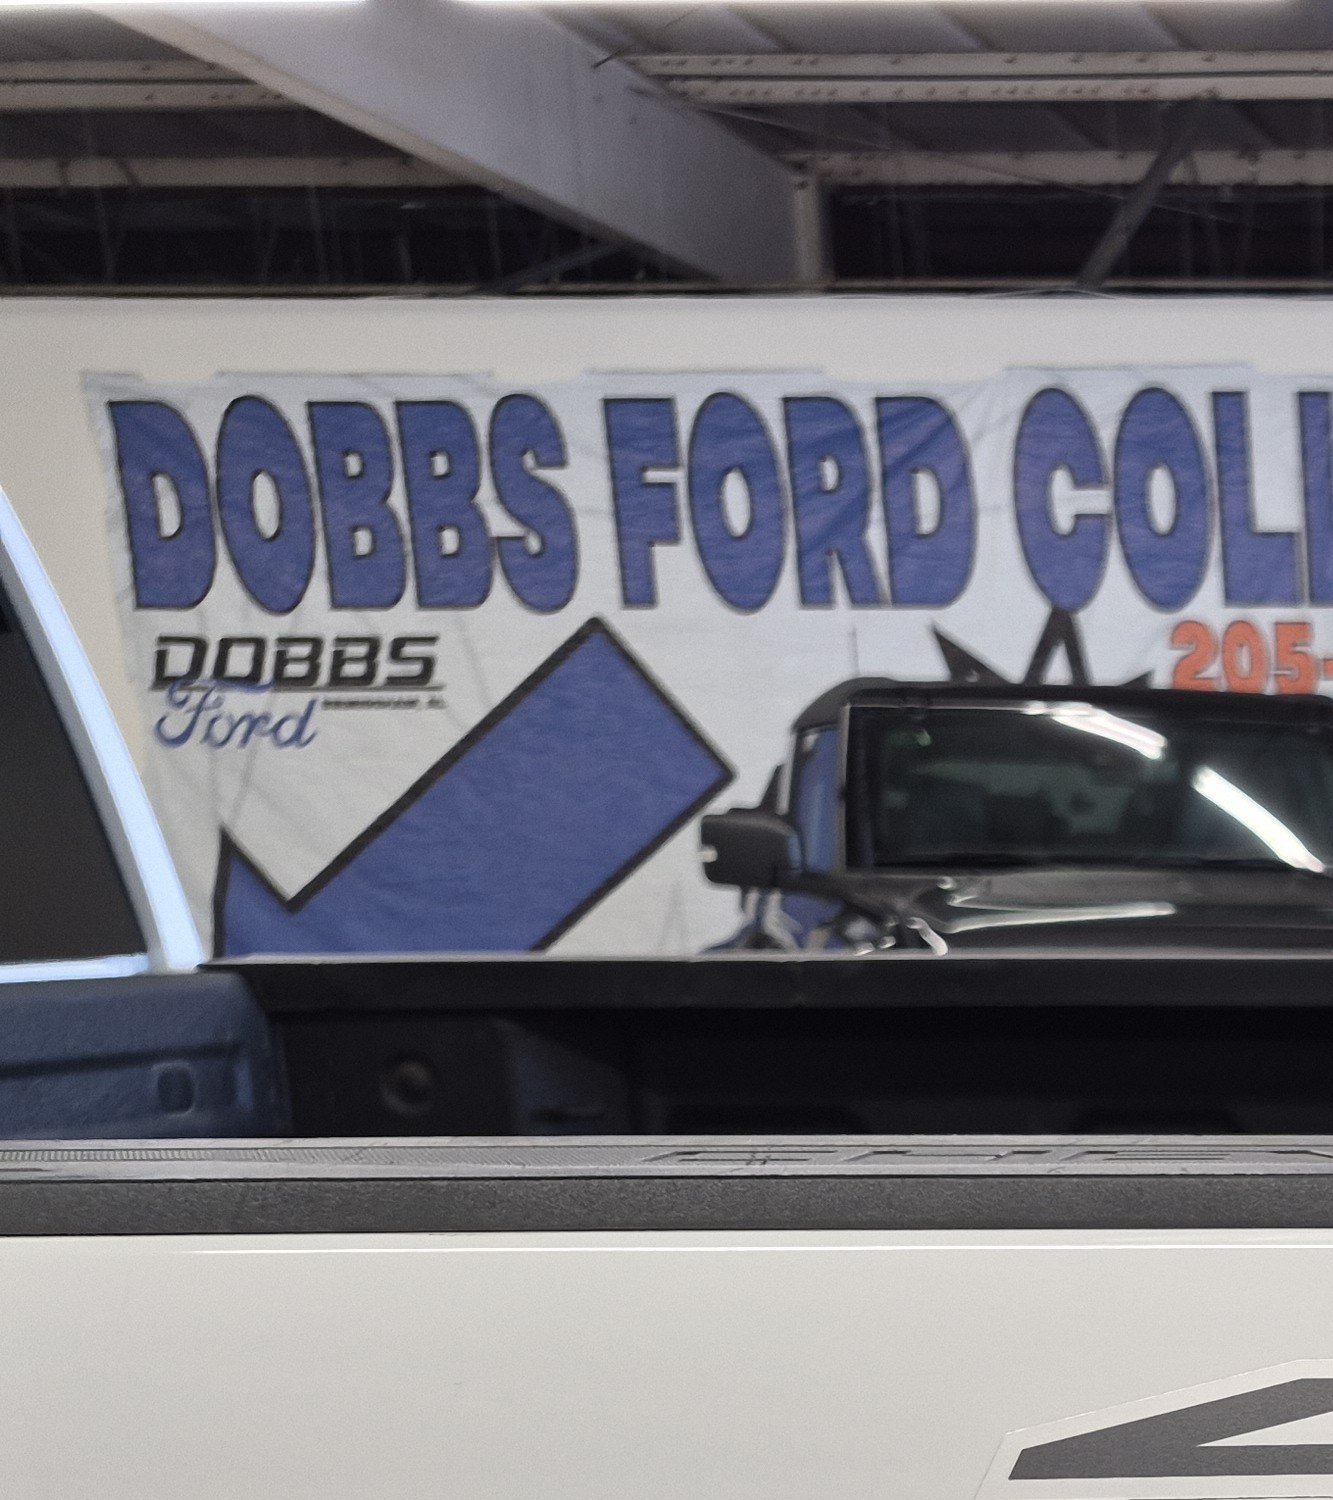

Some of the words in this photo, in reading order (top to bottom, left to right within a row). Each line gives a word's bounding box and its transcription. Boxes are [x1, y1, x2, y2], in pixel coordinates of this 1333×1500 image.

[107, 393, 580, 614] DOBBS
[602, 391, 978, 615] FORD
[151, 635, 441, 688] DOBBS
[154, 678, 320, 749] Ford
